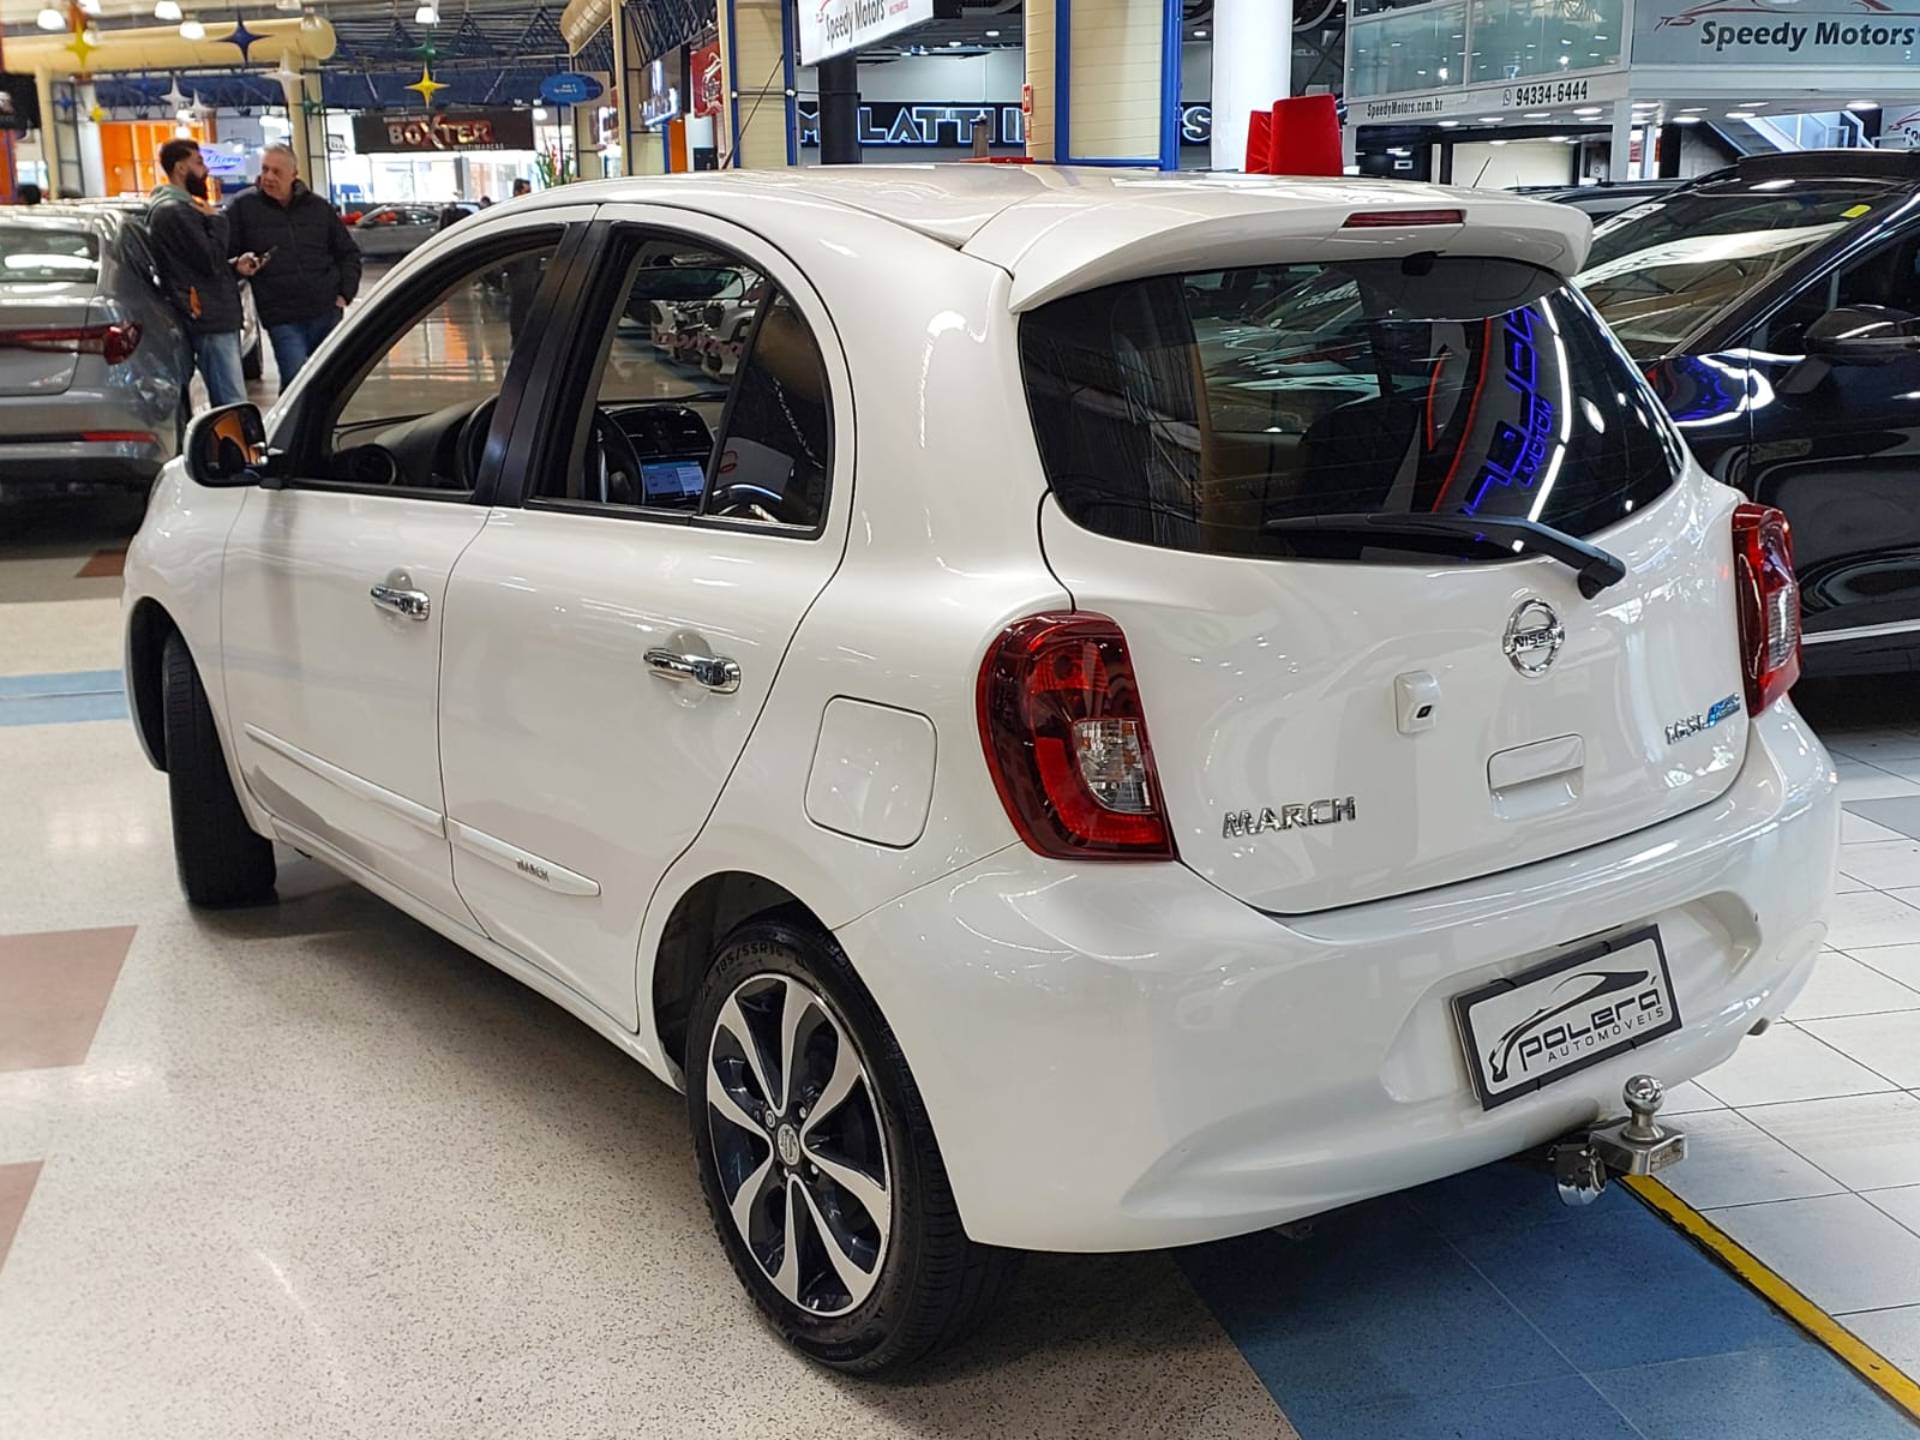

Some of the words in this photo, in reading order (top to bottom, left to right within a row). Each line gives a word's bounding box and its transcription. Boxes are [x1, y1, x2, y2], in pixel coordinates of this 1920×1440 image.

[826, 6, 853, 48] Speedy
[1700, 21, 1808, 52] Speedy
[1814, 21, 1915, 46] Motors
[1366, 97, 1443, 118] SpeedyMotors.com.br
[1516, 80, 1588, 106] 94334-6444
[388, 113, 492, 150] BOXTER
[1513, 628, 1565, 649] NISSAN
[1222, 796, 1356, 839] MARCH
[1547, 1006, 1665, 1064] AUTOMÓVEIS
